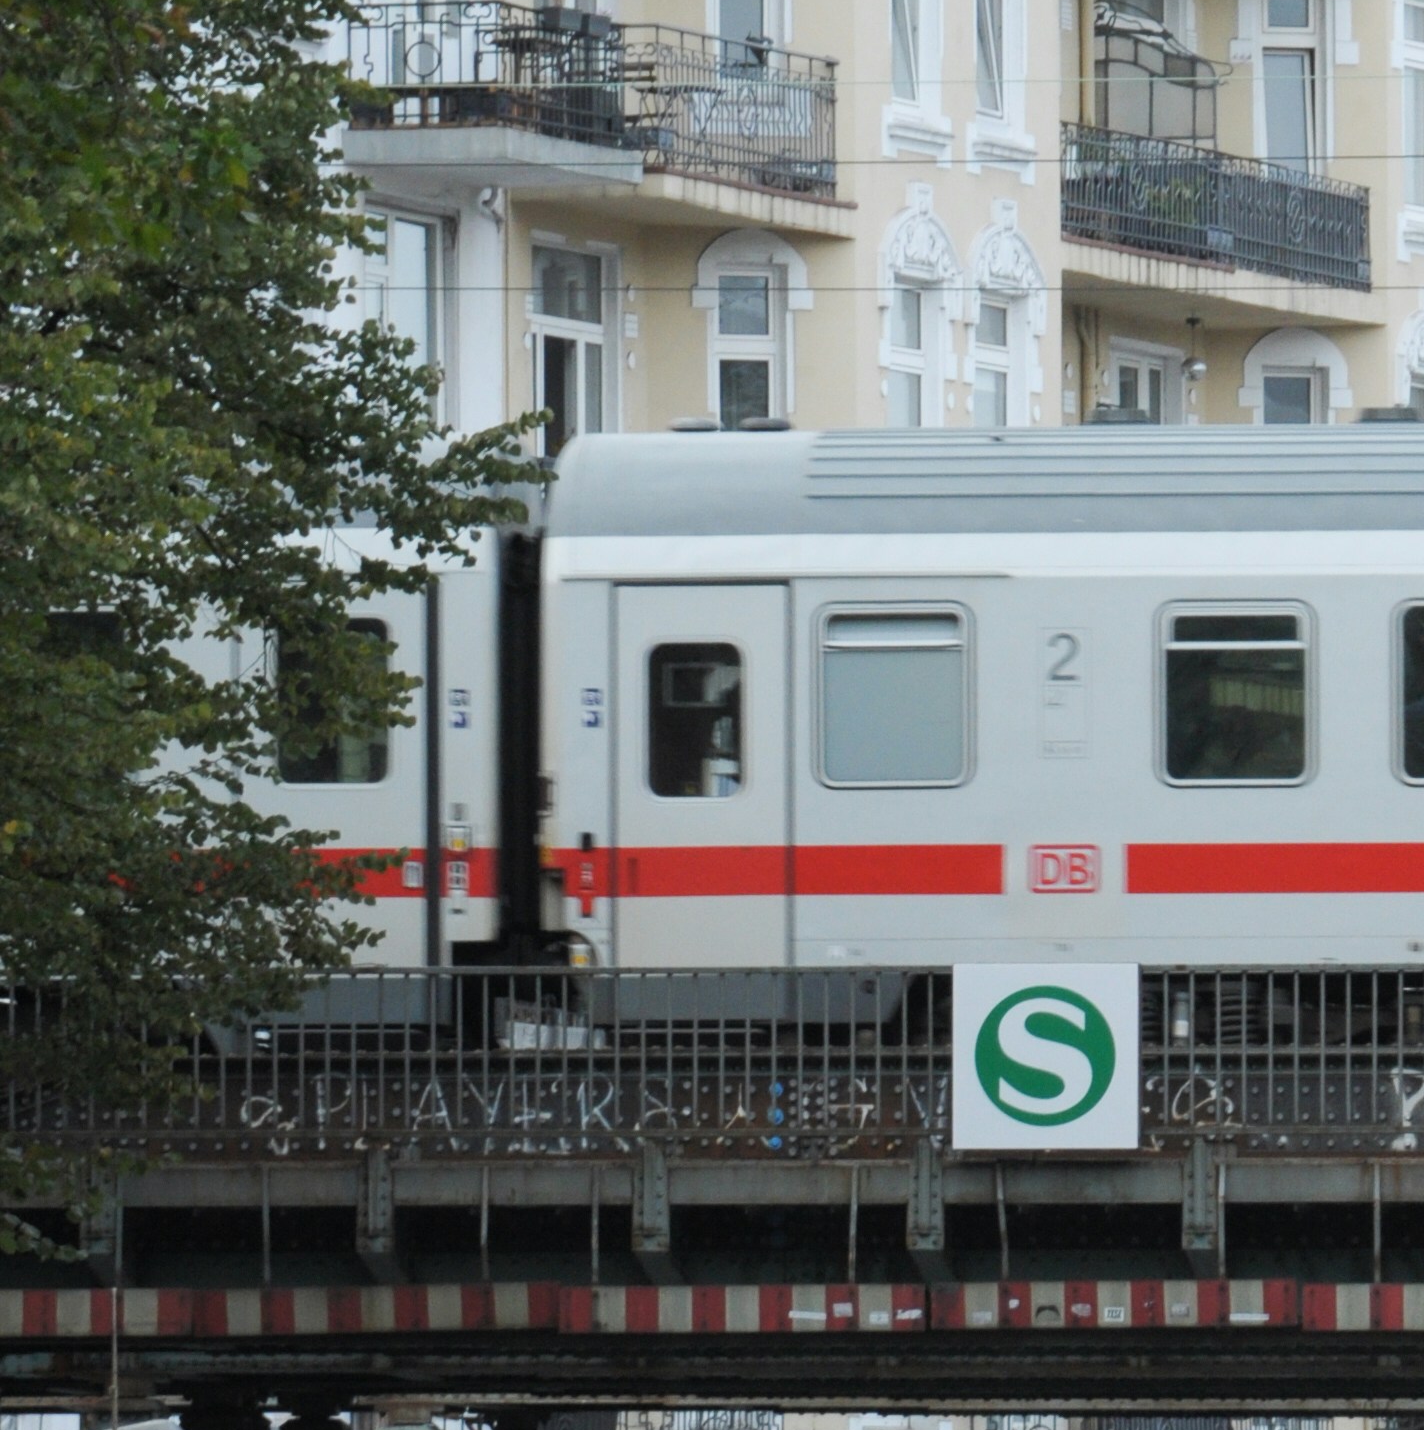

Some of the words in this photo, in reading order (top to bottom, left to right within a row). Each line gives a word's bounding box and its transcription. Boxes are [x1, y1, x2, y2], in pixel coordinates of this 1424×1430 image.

[1046, 632, 1081, 681] 2
[1039, 852, 1091, 885] DB
[997, 995, 1094, 1117] S
